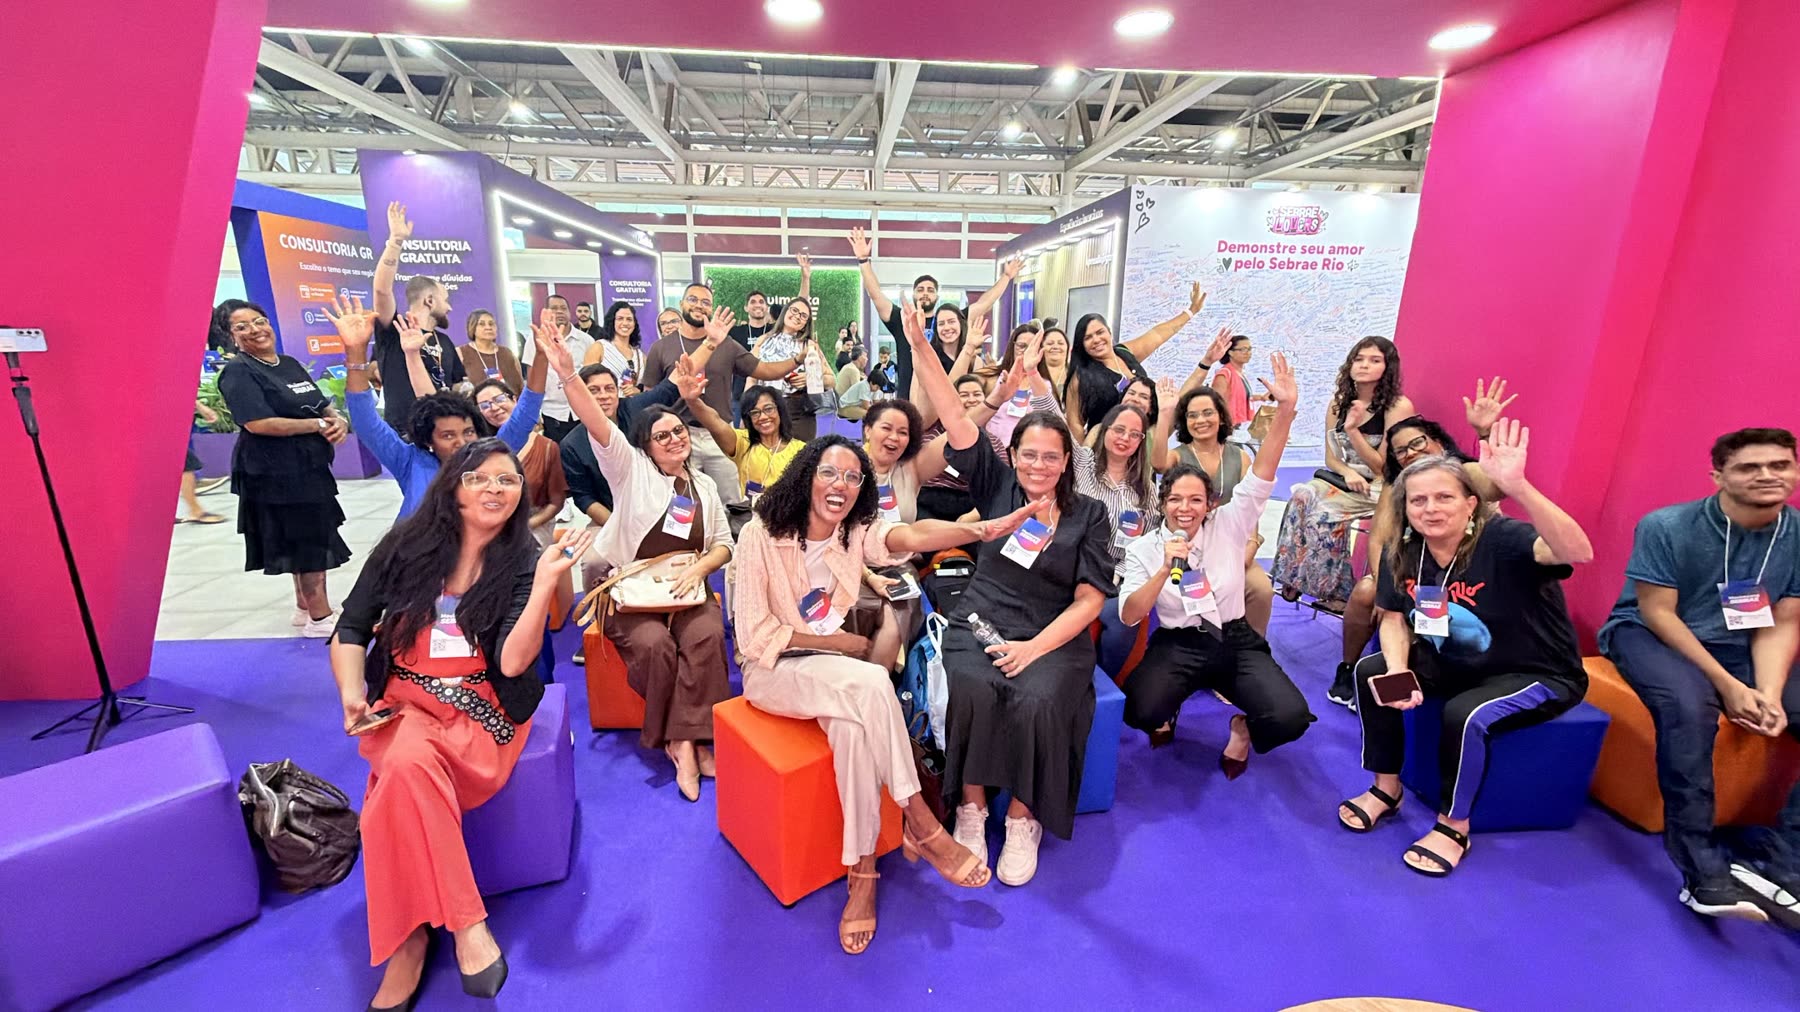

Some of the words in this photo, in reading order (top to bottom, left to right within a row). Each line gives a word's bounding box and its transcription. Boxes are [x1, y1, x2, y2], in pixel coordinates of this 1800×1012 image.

[279, 233, 358, 258] CONSULTORIA
[386, 240, 472, 251] NSULTORIA
[1217, 240, 1297, 255] Demonstre
[1300, 244, 1325, 255] seu
[1328, 244, 1365, 256] amor
[400, 253, 462, 264] GRATUITA
[1234, 257, 1265, 272] pelo
[1269, 257, 1318, 271] Sebrae
[1322, 258, 1345, 271] Rio
[442, 273, 473, 282] dúvidas
